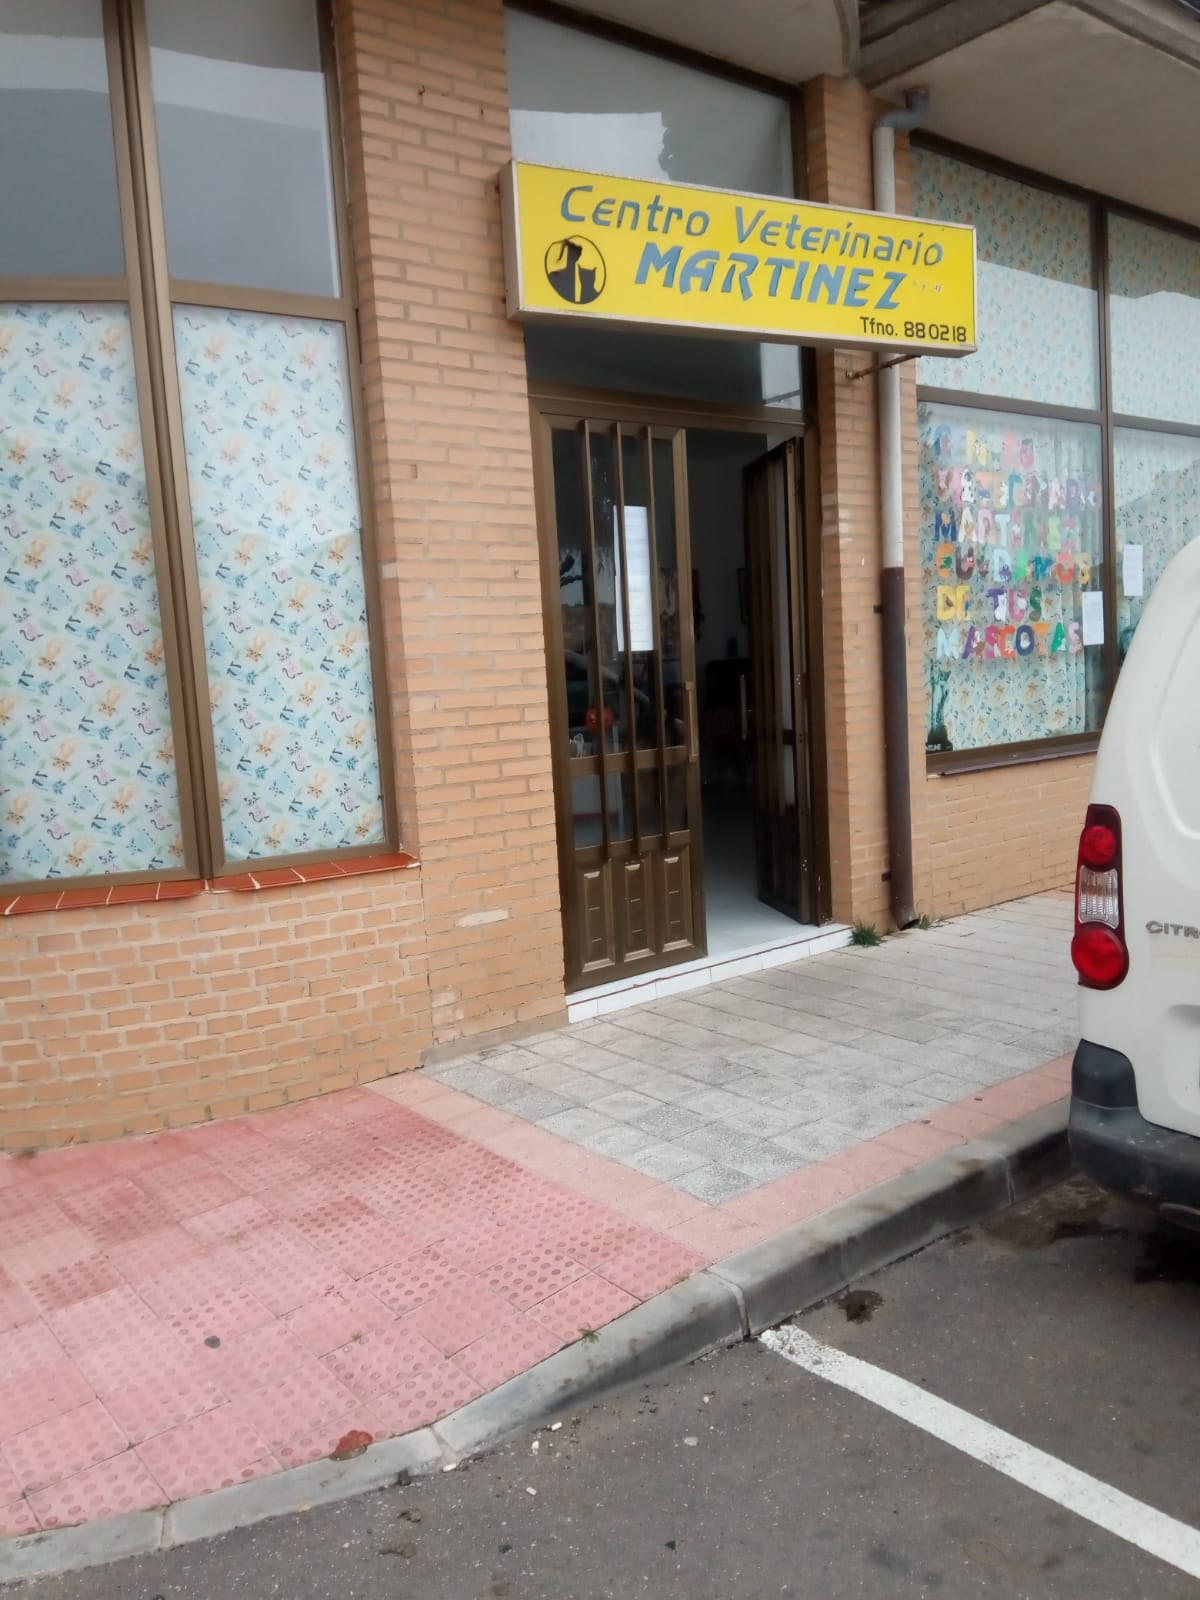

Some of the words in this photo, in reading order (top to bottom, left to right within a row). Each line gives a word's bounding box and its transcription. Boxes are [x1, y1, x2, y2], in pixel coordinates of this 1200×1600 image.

[561, 185, 710, 236] Centro
[735, 206, 943, 266] Veterinario
[634, 242, 907, 310] MARTINEZ
[859, 316, 898, 336] Tfno.
[935, 543, 1091, 585] CUIDAMOS
[936, 584, 971, 621] DE
[987, 586, 1042, 622] TUS
[936, 622, 1082, 660] MASCOTAS
[1145, 920, 1200, 939] CITR
